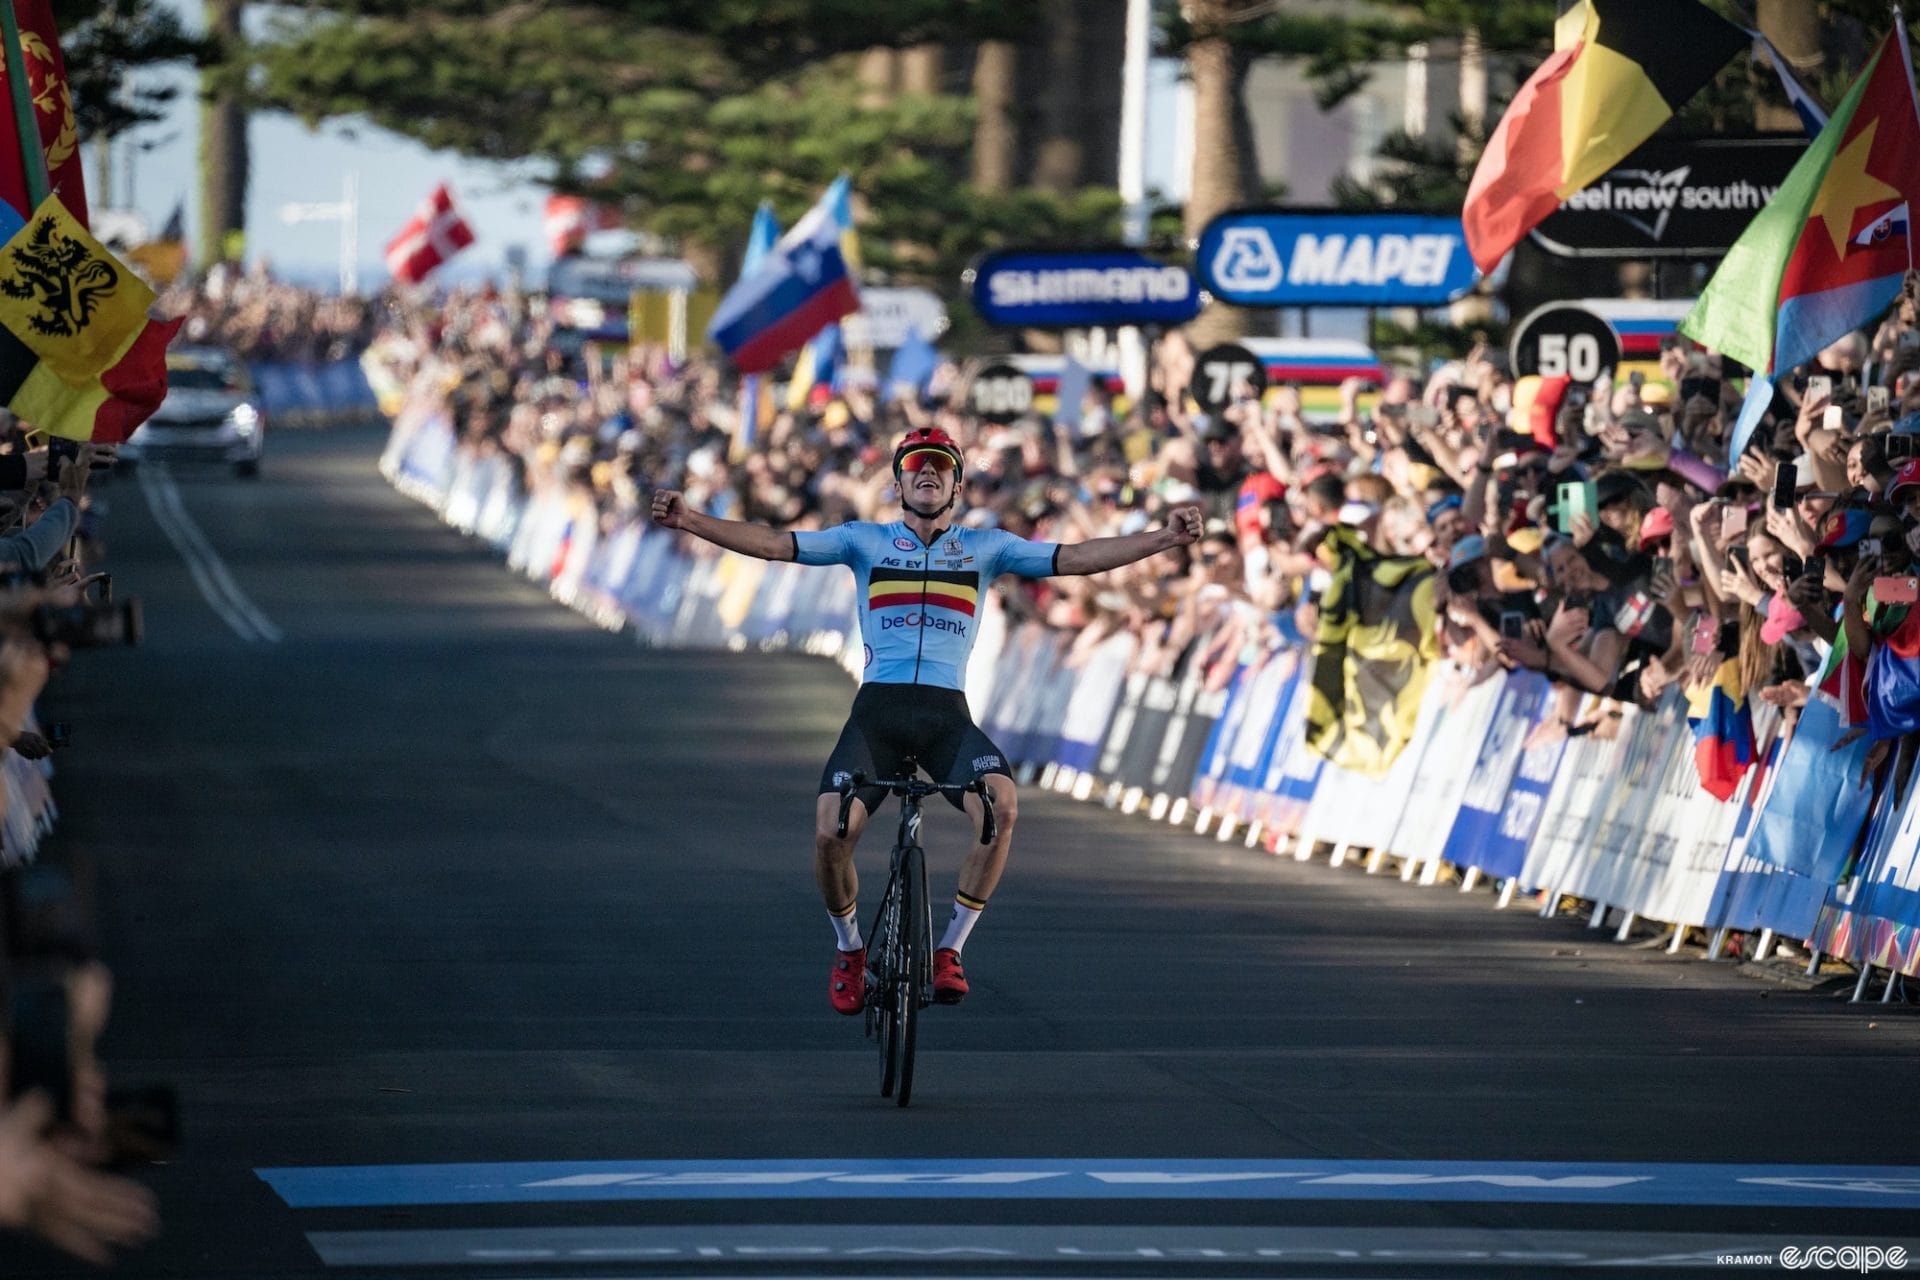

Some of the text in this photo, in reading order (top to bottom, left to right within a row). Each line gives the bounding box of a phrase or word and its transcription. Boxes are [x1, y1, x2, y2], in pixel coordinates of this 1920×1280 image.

[1615, 187, 1677, 210] new
[1682, 180, 1758, 210] south
[1289, 234, 1455, 286] MAPEI
[989, 267, 1190, 306] SHIMANO
[1538, 333, 1599, 378] 50
[880, 556, 922, 569] AG EY
